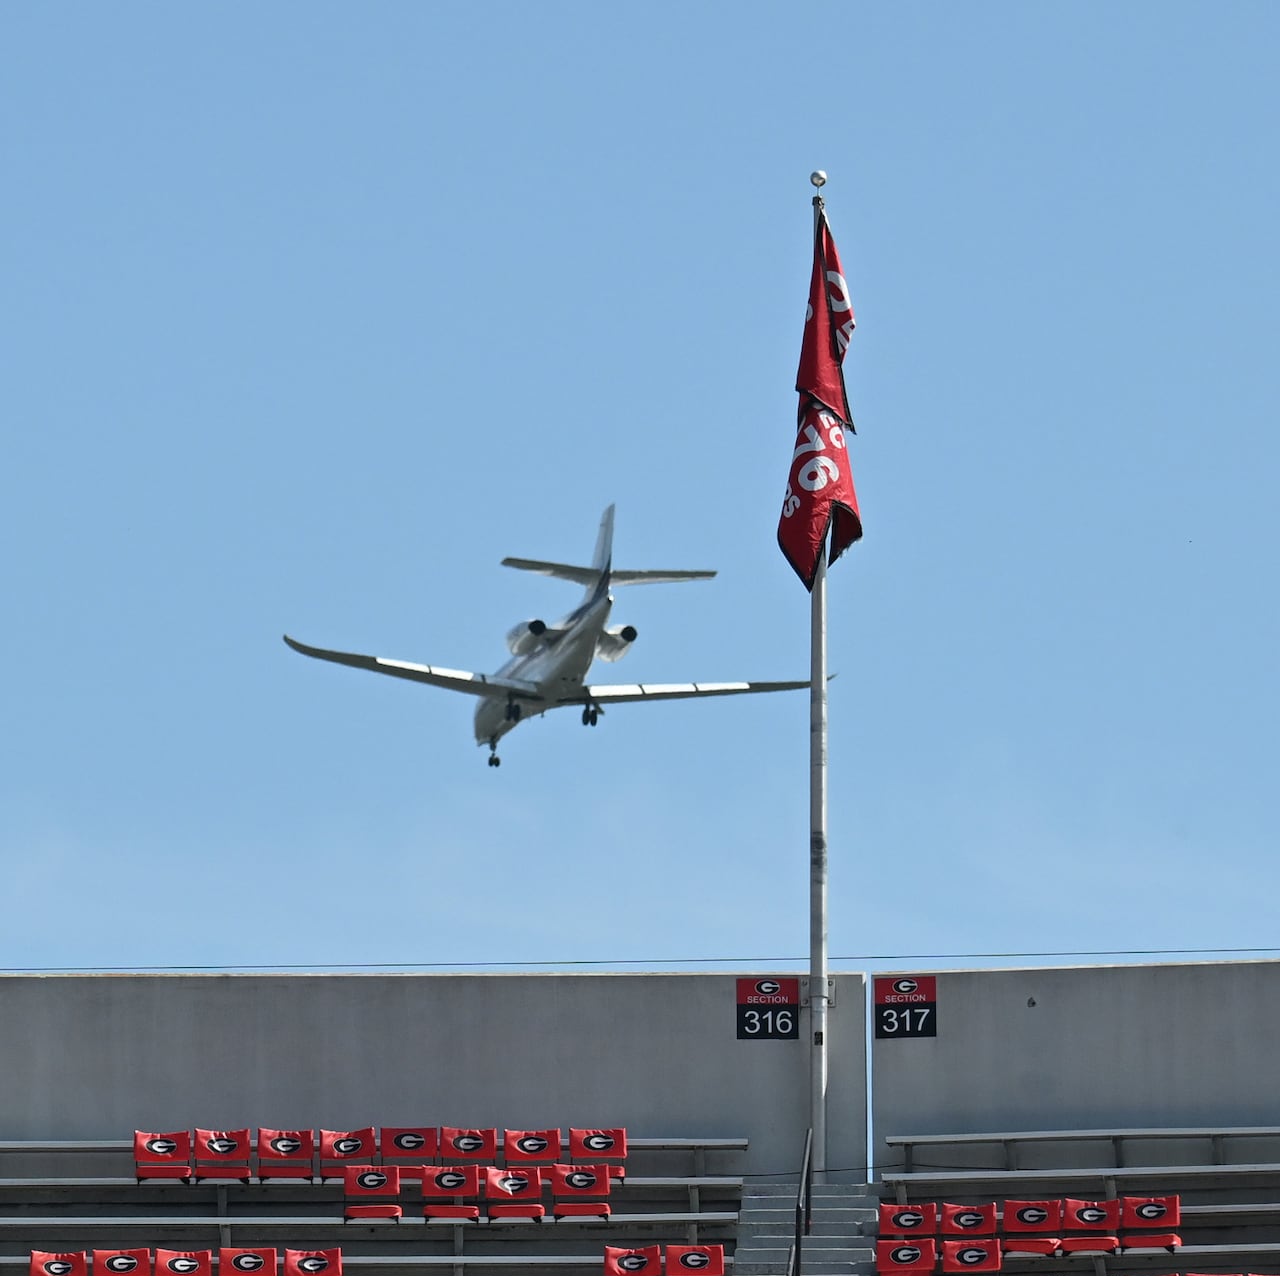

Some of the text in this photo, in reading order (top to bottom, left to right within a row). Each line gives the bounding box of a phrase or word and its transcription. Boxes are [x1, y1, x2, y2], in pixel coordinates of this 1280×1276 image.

[747, 995, 789, 1004] SECTION
[885, 993, 926, 1003] SECTION
[744, 1010, 793, 1034] 316
[882, 1008, 930, 1033] 317
